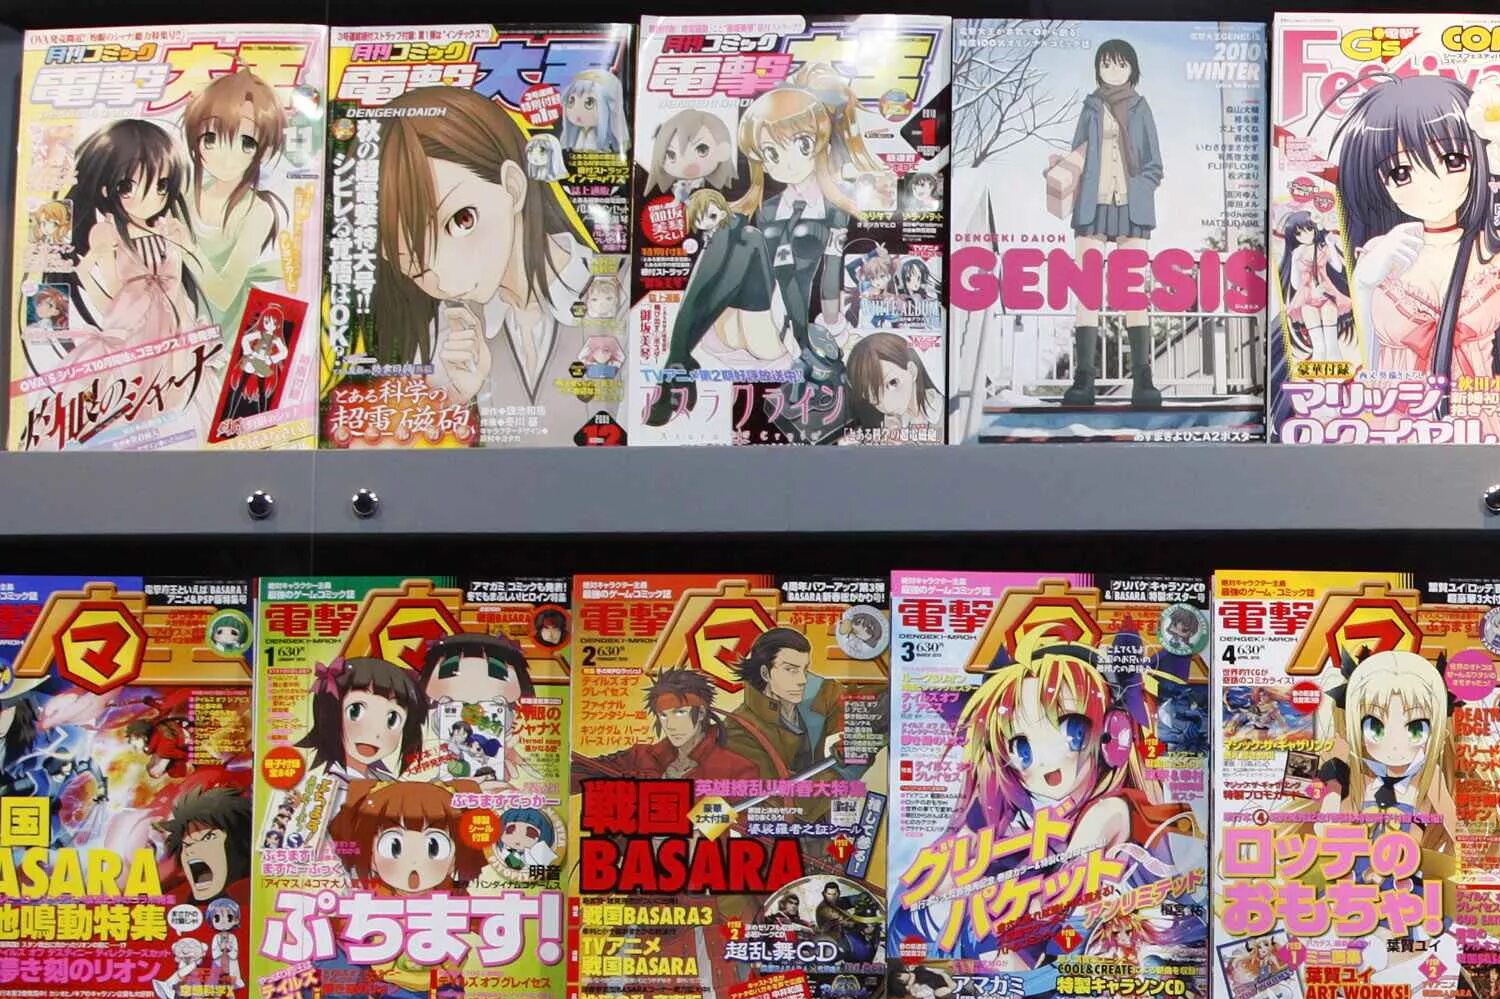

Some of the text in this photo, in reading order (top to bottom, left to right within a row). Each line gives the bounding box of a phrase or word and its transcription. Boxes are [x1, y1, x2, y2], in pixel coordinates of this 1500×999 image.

[44, 42, 158, 64] 月刊コミック
[350, 42, 468, 61] 月刊コミック
[663, 34, 777, 53] 月刊コミック
[1214, 43, 1260, 59] 2010
[30, 63, 172, 108] 電撃
[1186, 63, 1260, 80] WINTER
[955, 234, 1015, 242] DENGEKI
[948, 246, 1266, 312] GENESIS
[335, 380, 447, 401] とある科学の
[1281, 377, 1448, 417] マリッジ
[265, 603, 357, 638] 電撃
[580, 602, 674, 637] 電撃
[898, 599, 993, 633] 電撃
[1218, 601, 1313, 636] 電撃
[901, 643, 914, 661] 3
[581, 779, 695, 836] 戦国
[580, 837, 805, 894] BASARA
[902, 800, 1076, 908] グリード
[1223, 826, 1422, 879] ロッテの
[529, 865, 561, 880] 明音
[940, 848, 1127, 949] パケット
[1223, 879, 1445, 937] おもちゃ!
[260, 890, 563, 966] ぷちます!
[581, 938, 661, 955] TVアニメ
[724, 941, 838, 963] 超乱舞CD
[952, 974, 1024, 994] アマガミ
